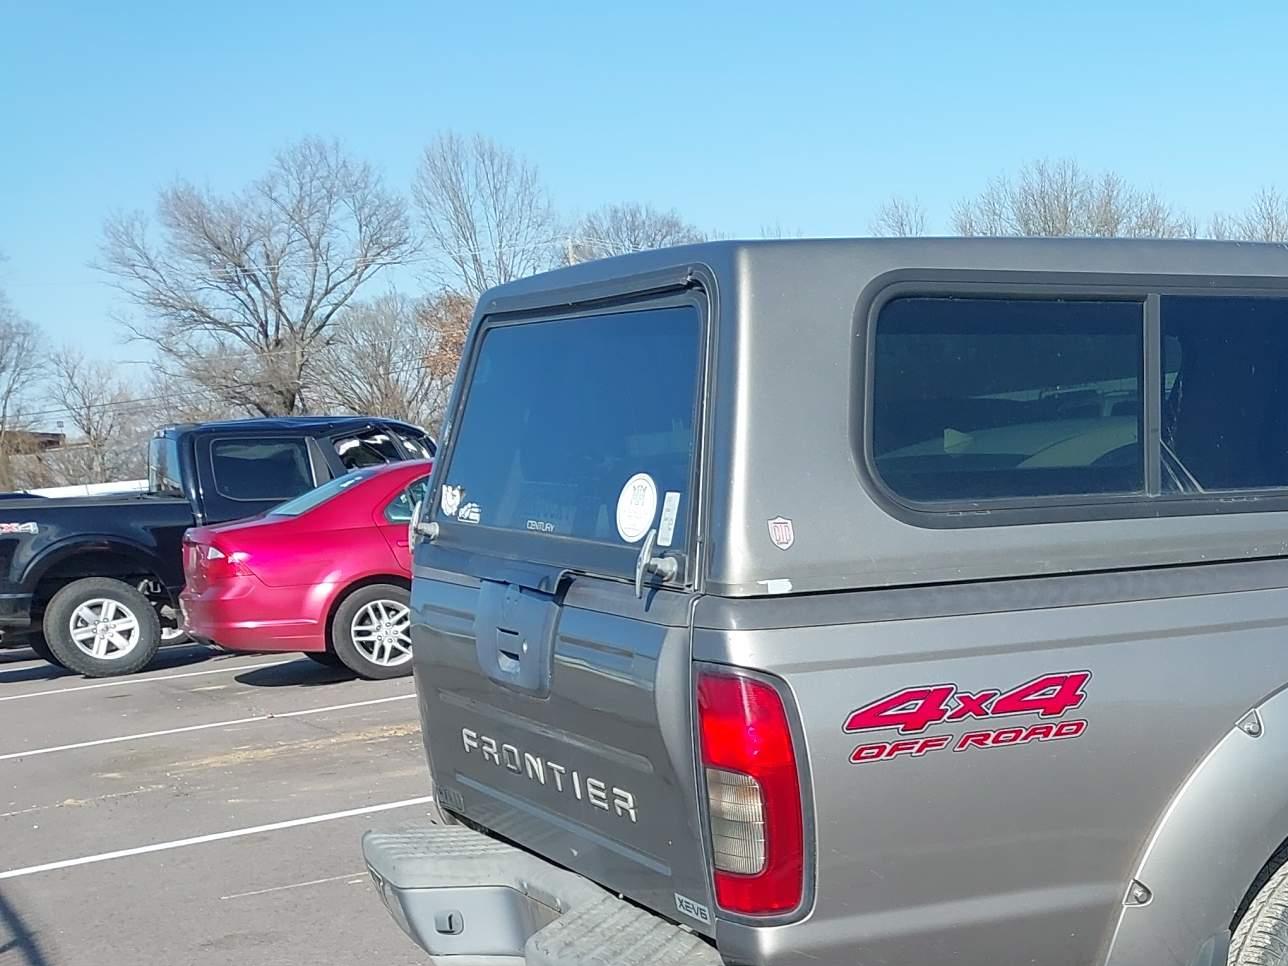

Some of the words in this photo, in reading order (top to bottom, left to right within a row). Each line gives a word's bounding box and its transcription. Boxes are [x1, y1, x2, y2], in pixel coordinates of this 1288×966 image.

[526, 520, 556, 532] CENTURY
[849, 734, 953, 764] OFF
[953, 720, 1088, 752] ROAD
[461, 727, 638, 823] FRONTIER
